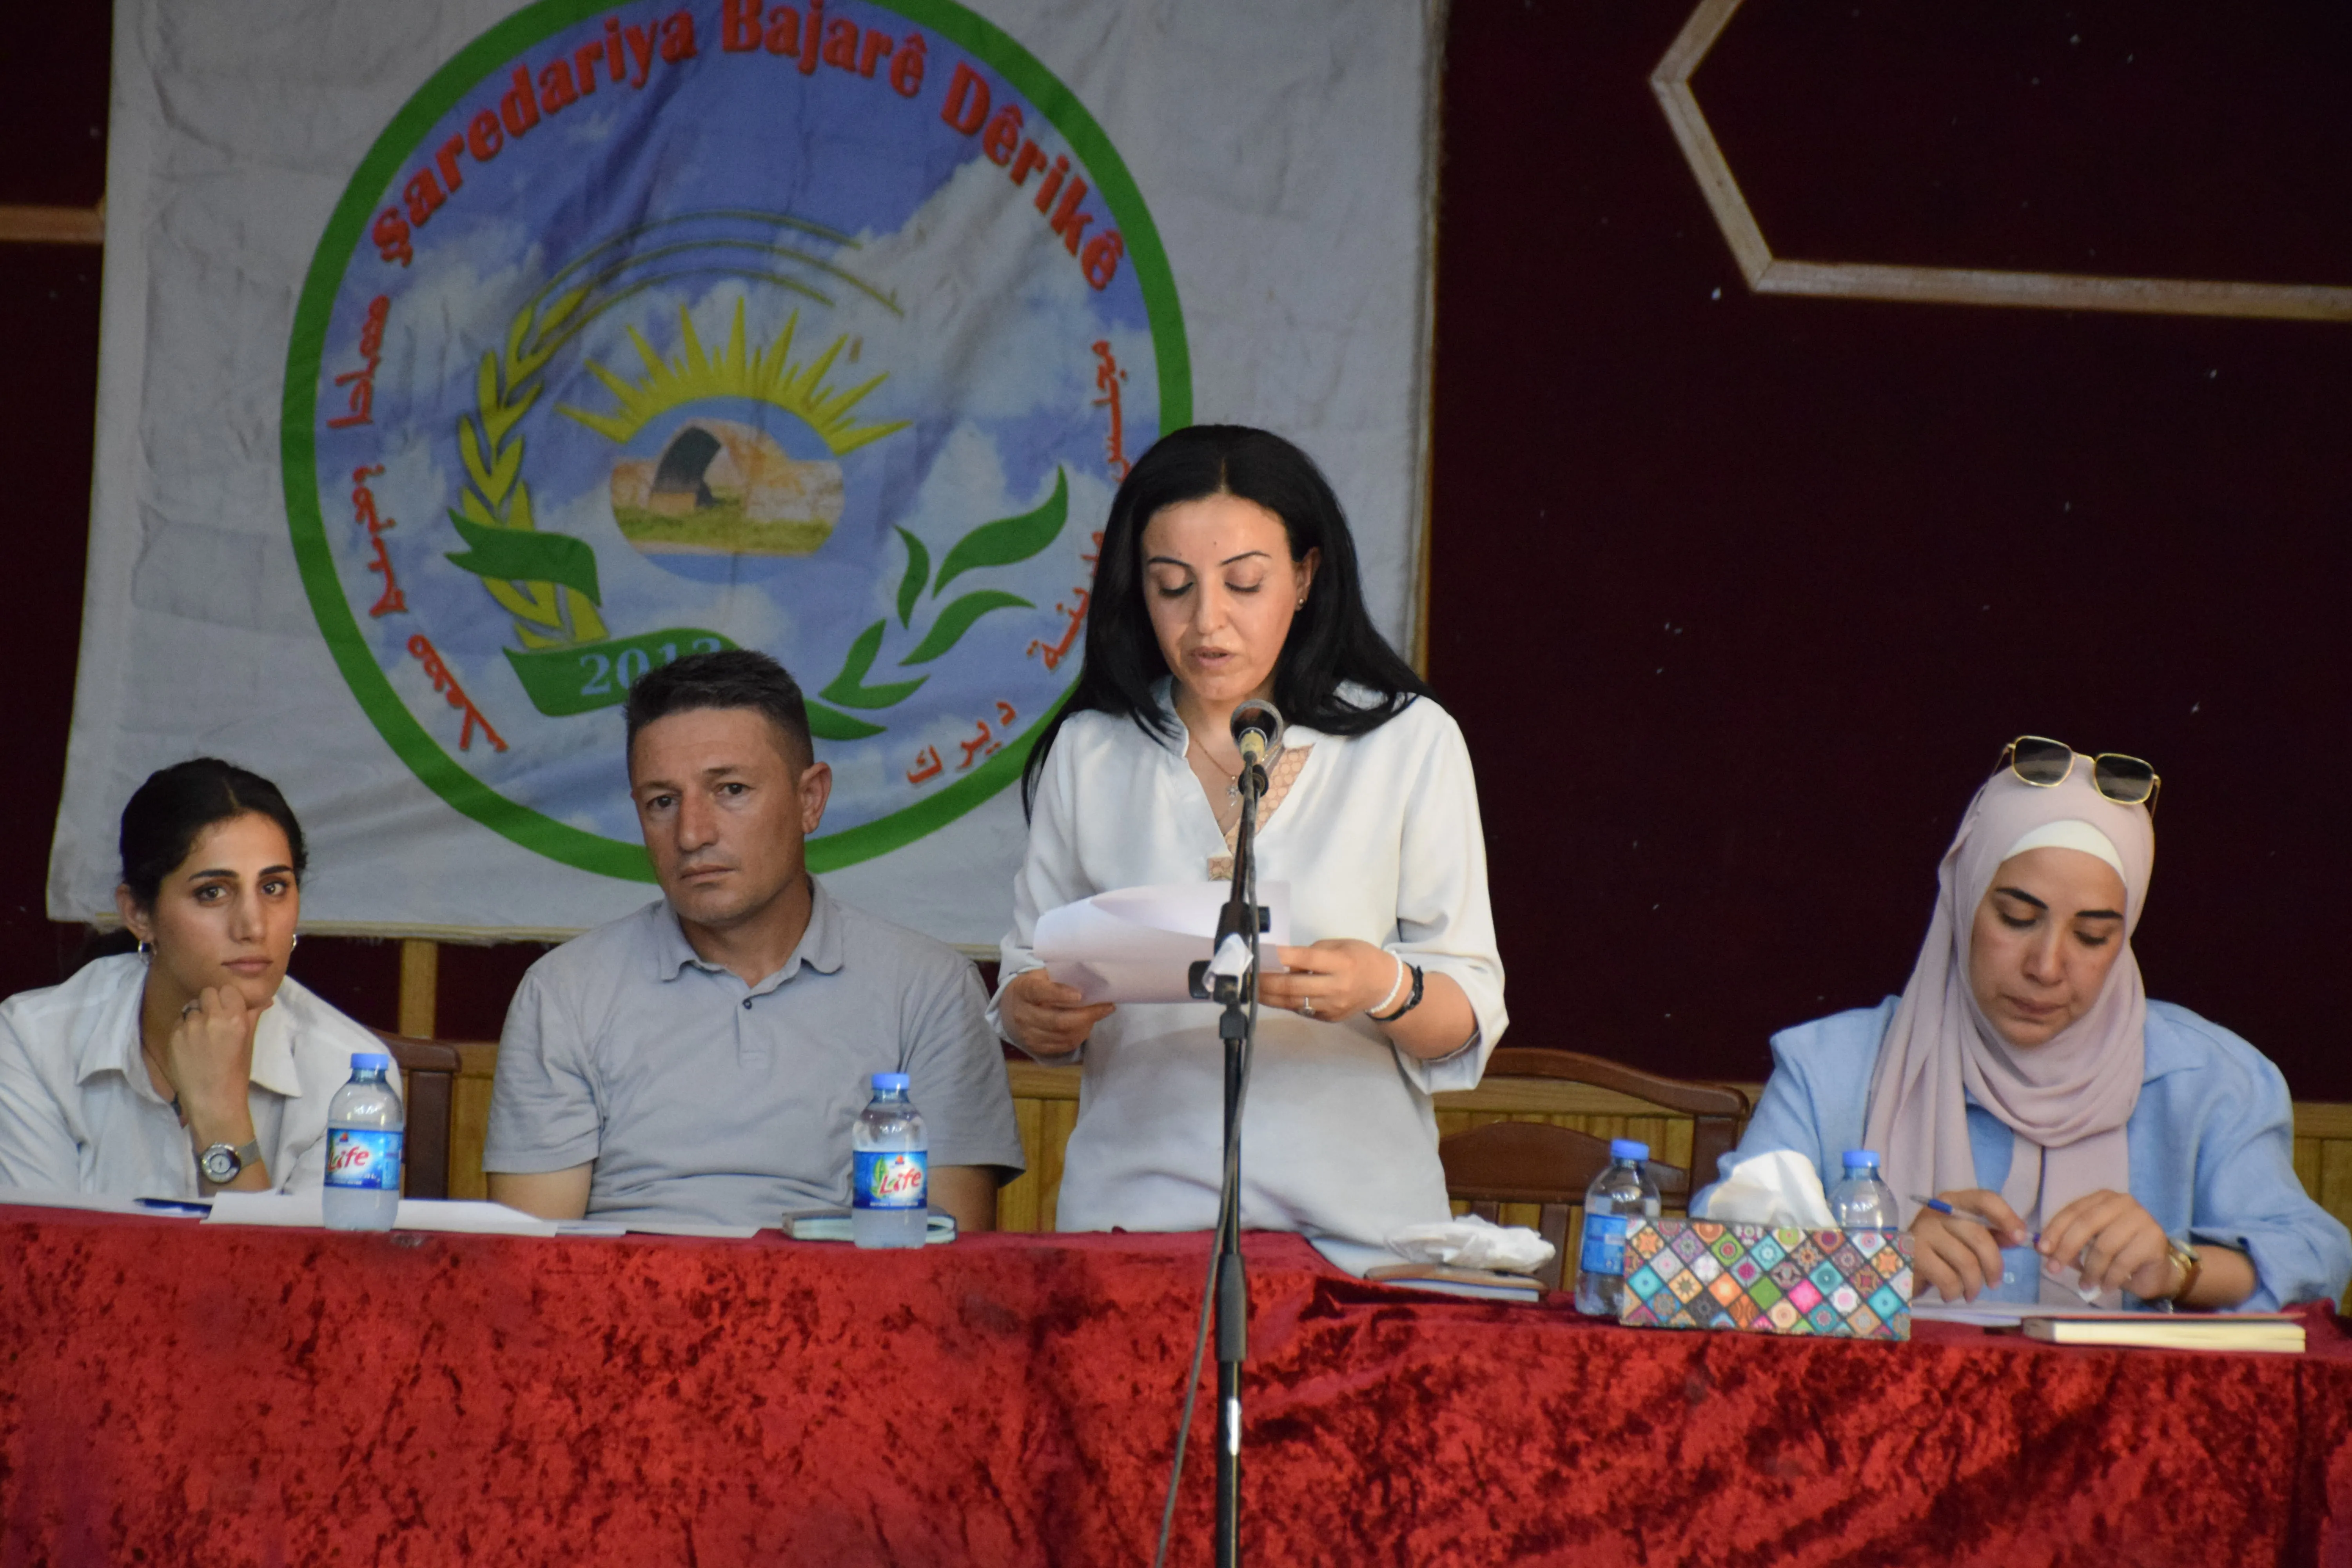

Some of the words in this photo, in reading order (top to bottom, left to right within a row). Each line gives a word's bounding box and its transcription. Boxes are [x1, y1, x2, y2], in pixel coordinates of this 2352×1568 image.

[722, 0, 927, 97] Bajarê
[941, 62, 1123, 290] Dêrikê
[906, 701, 1016, 784] ديرك
[328, 1145, 369, 1172] Life
[879, 1168, 922, 1195] Life
